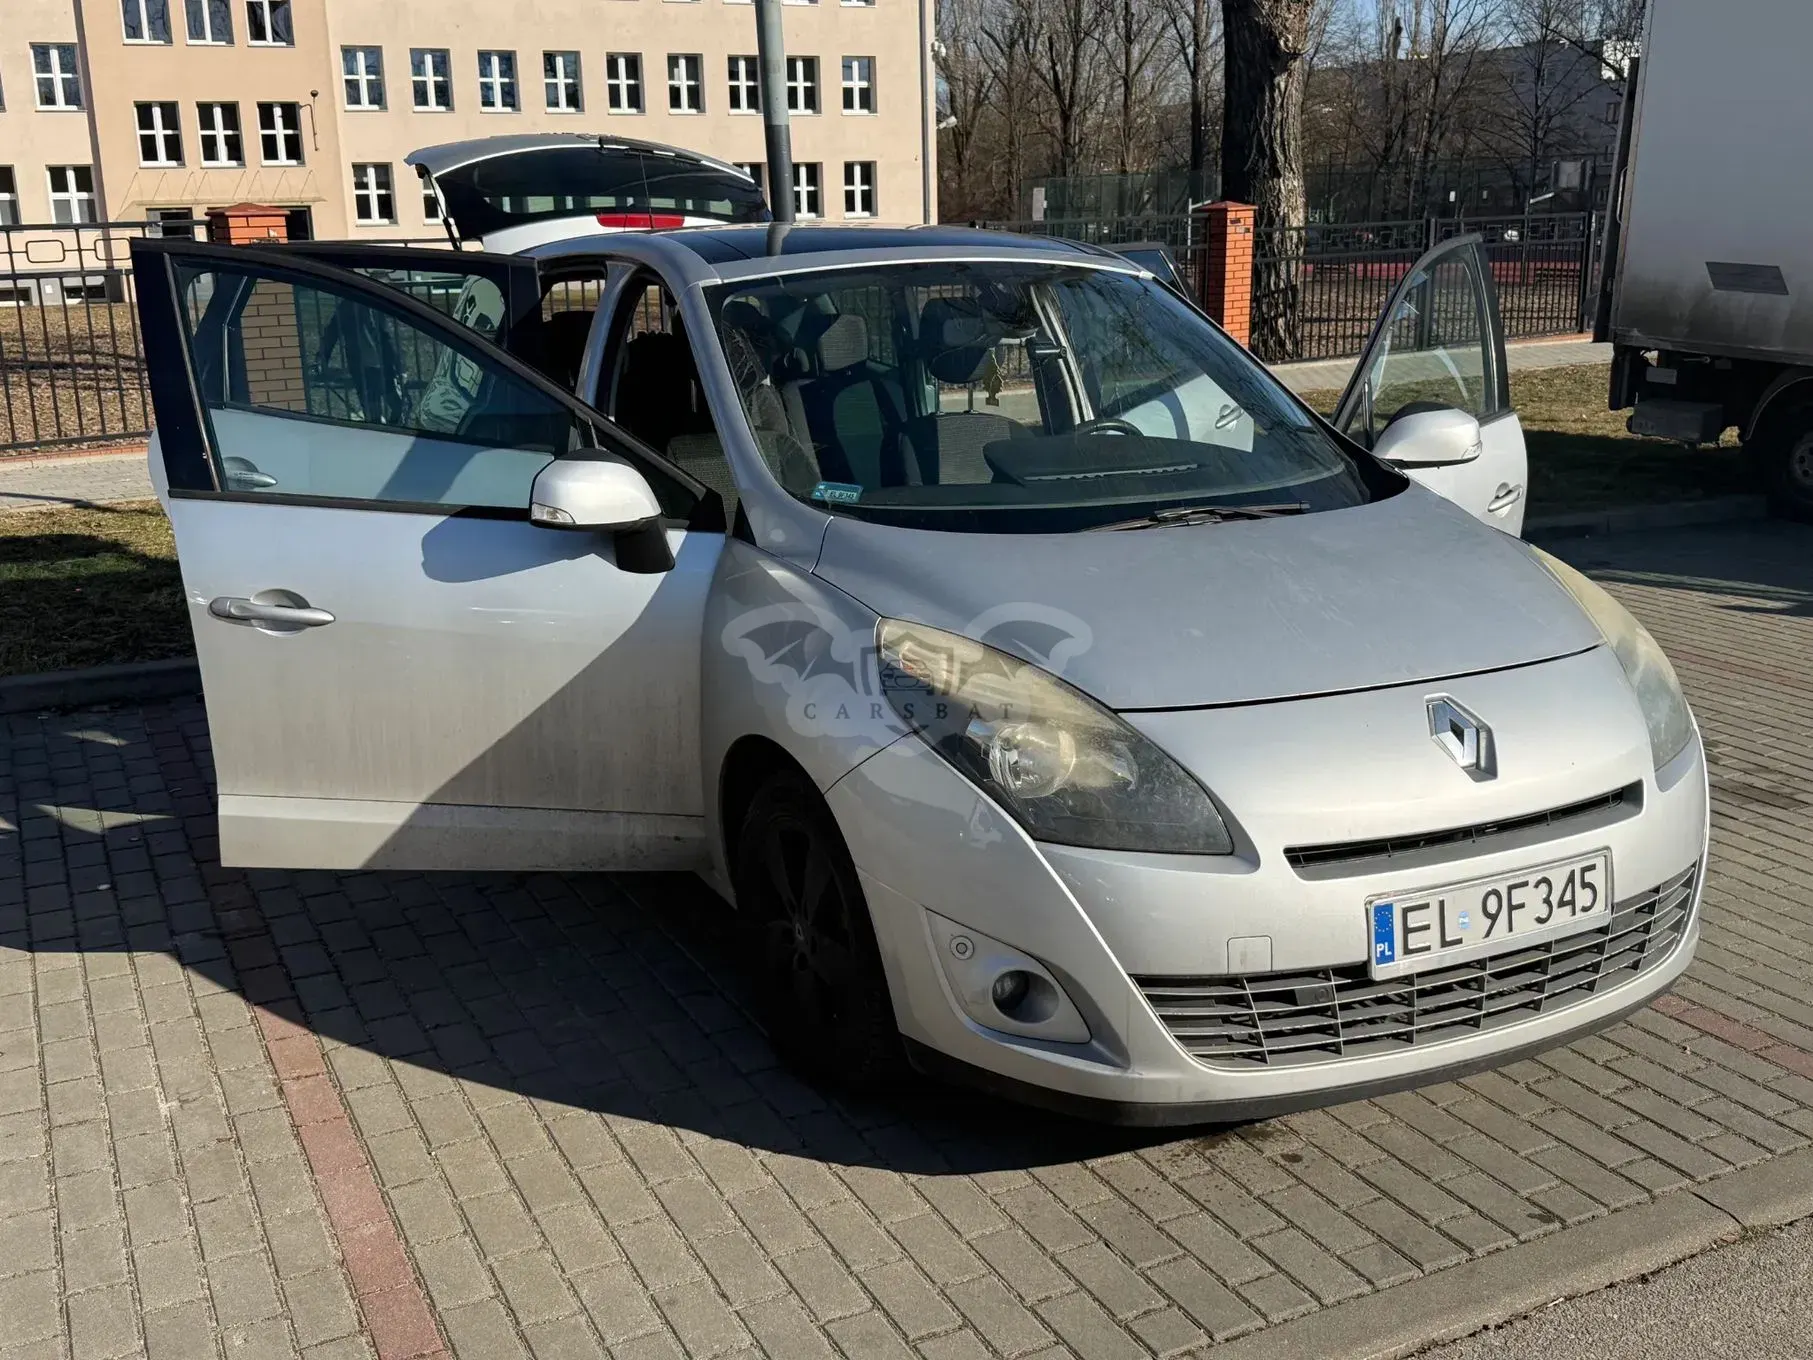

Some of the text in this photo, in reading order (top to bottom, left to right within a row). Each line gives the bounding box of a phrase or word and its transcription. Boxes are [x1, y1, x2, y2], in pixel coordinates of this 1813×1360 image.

[1401, 863, 1598, 955] EL 9F345
[1376, 942, 1393, 957] PL
